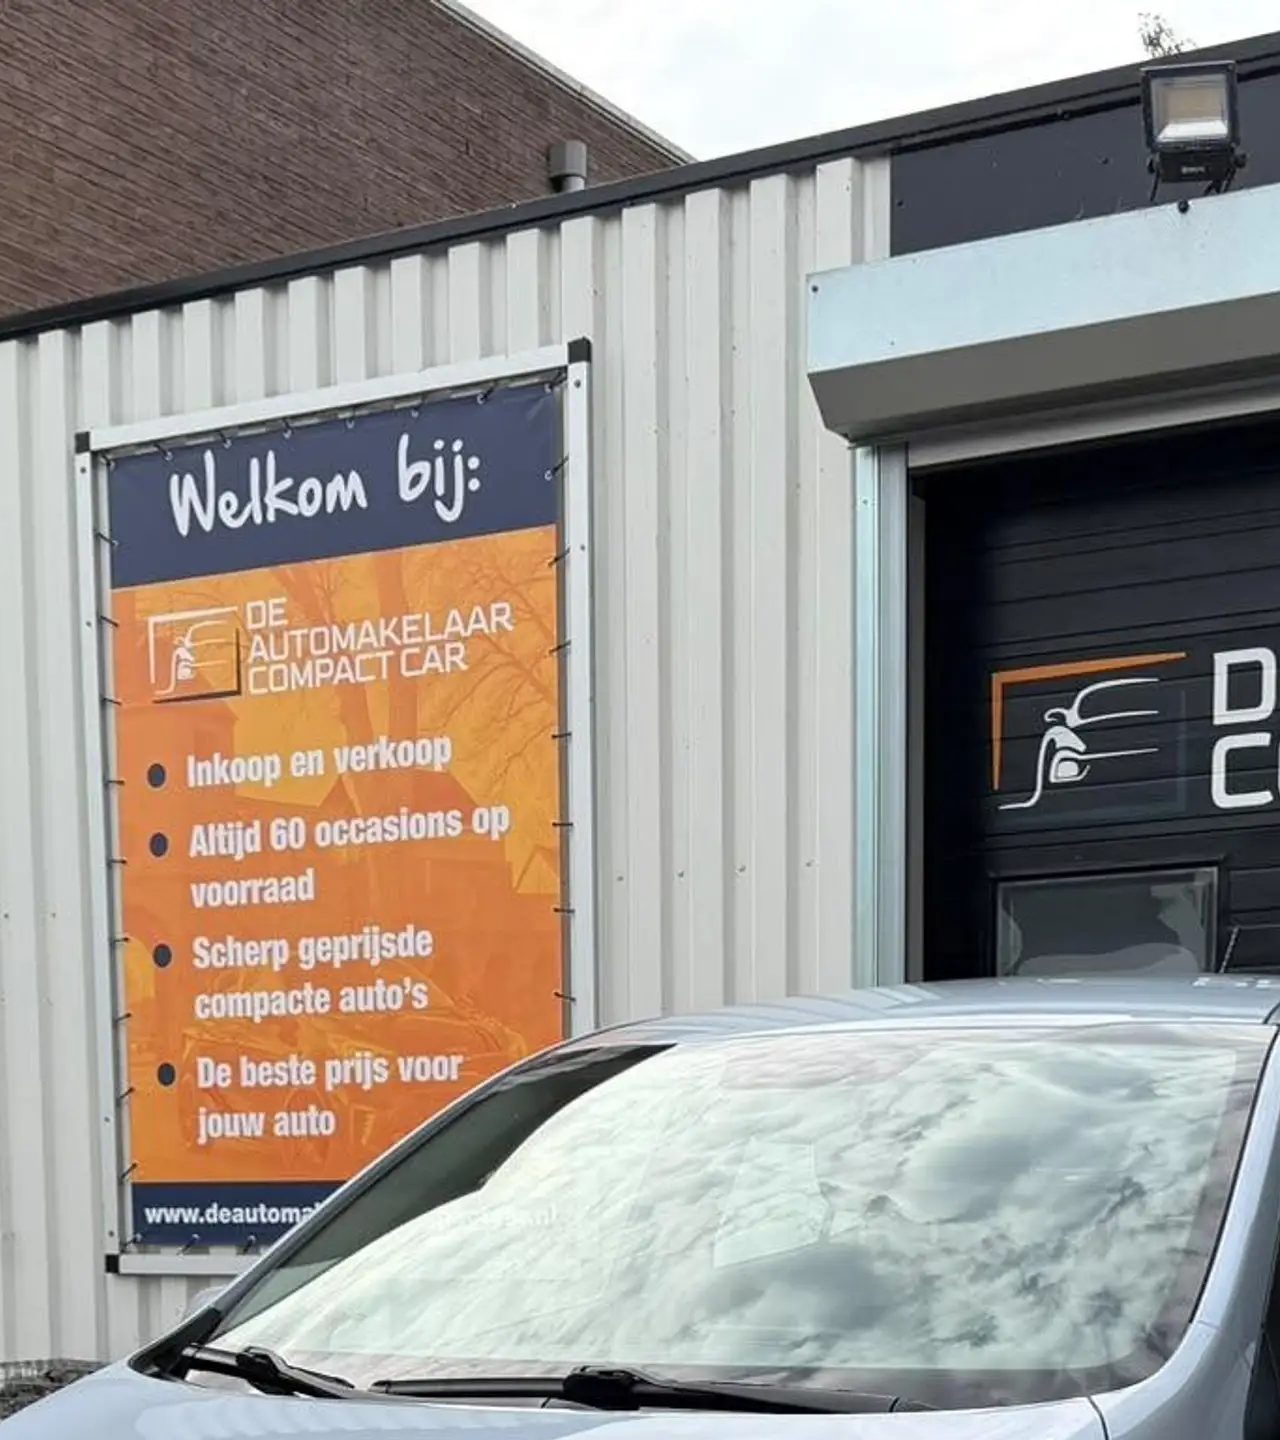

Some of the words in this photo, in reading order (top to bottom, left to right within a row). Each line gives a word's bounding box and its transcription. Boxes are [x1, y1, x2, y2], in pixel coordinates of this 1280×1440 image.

[169, 450, 368, 537] Welkom
[397, 433, 482, 523] bij:
[246, 597, 289, 632] DE
[247, 602, 516, 664] AUTOMAKELAAR
[248, 651, 392, 696] COMPACT
[399, 643, 470, 680] CAR
[187, 751, 281, 790] Inkoop
[290, 746, 325, 777] en
[332, 734, 453, 774] verkoop
[190, 820, 262, 863] Altijd
[269, 815, 307, 852] 60
[314, 807, 463, 849] occasions
[471, 804, 511, 840] op
[191, 866, 316, 910] voorraad
[192, 935, 290, 973] Scherp
[298, 923, 434, 973] geprijsde
[195, 984, 332, 1024] compacte
[339, 977, 430, 1012] auto's
[196, 1057, 233, 1089] De
[239, 1052, 317, 1088] beste
[325, 1052, 391, 1092] prijs
[398, 1052, 464, 1082] voor
[197, 1107, 264, 1145] jouw
[272, 1105, 336, 1139] auto
